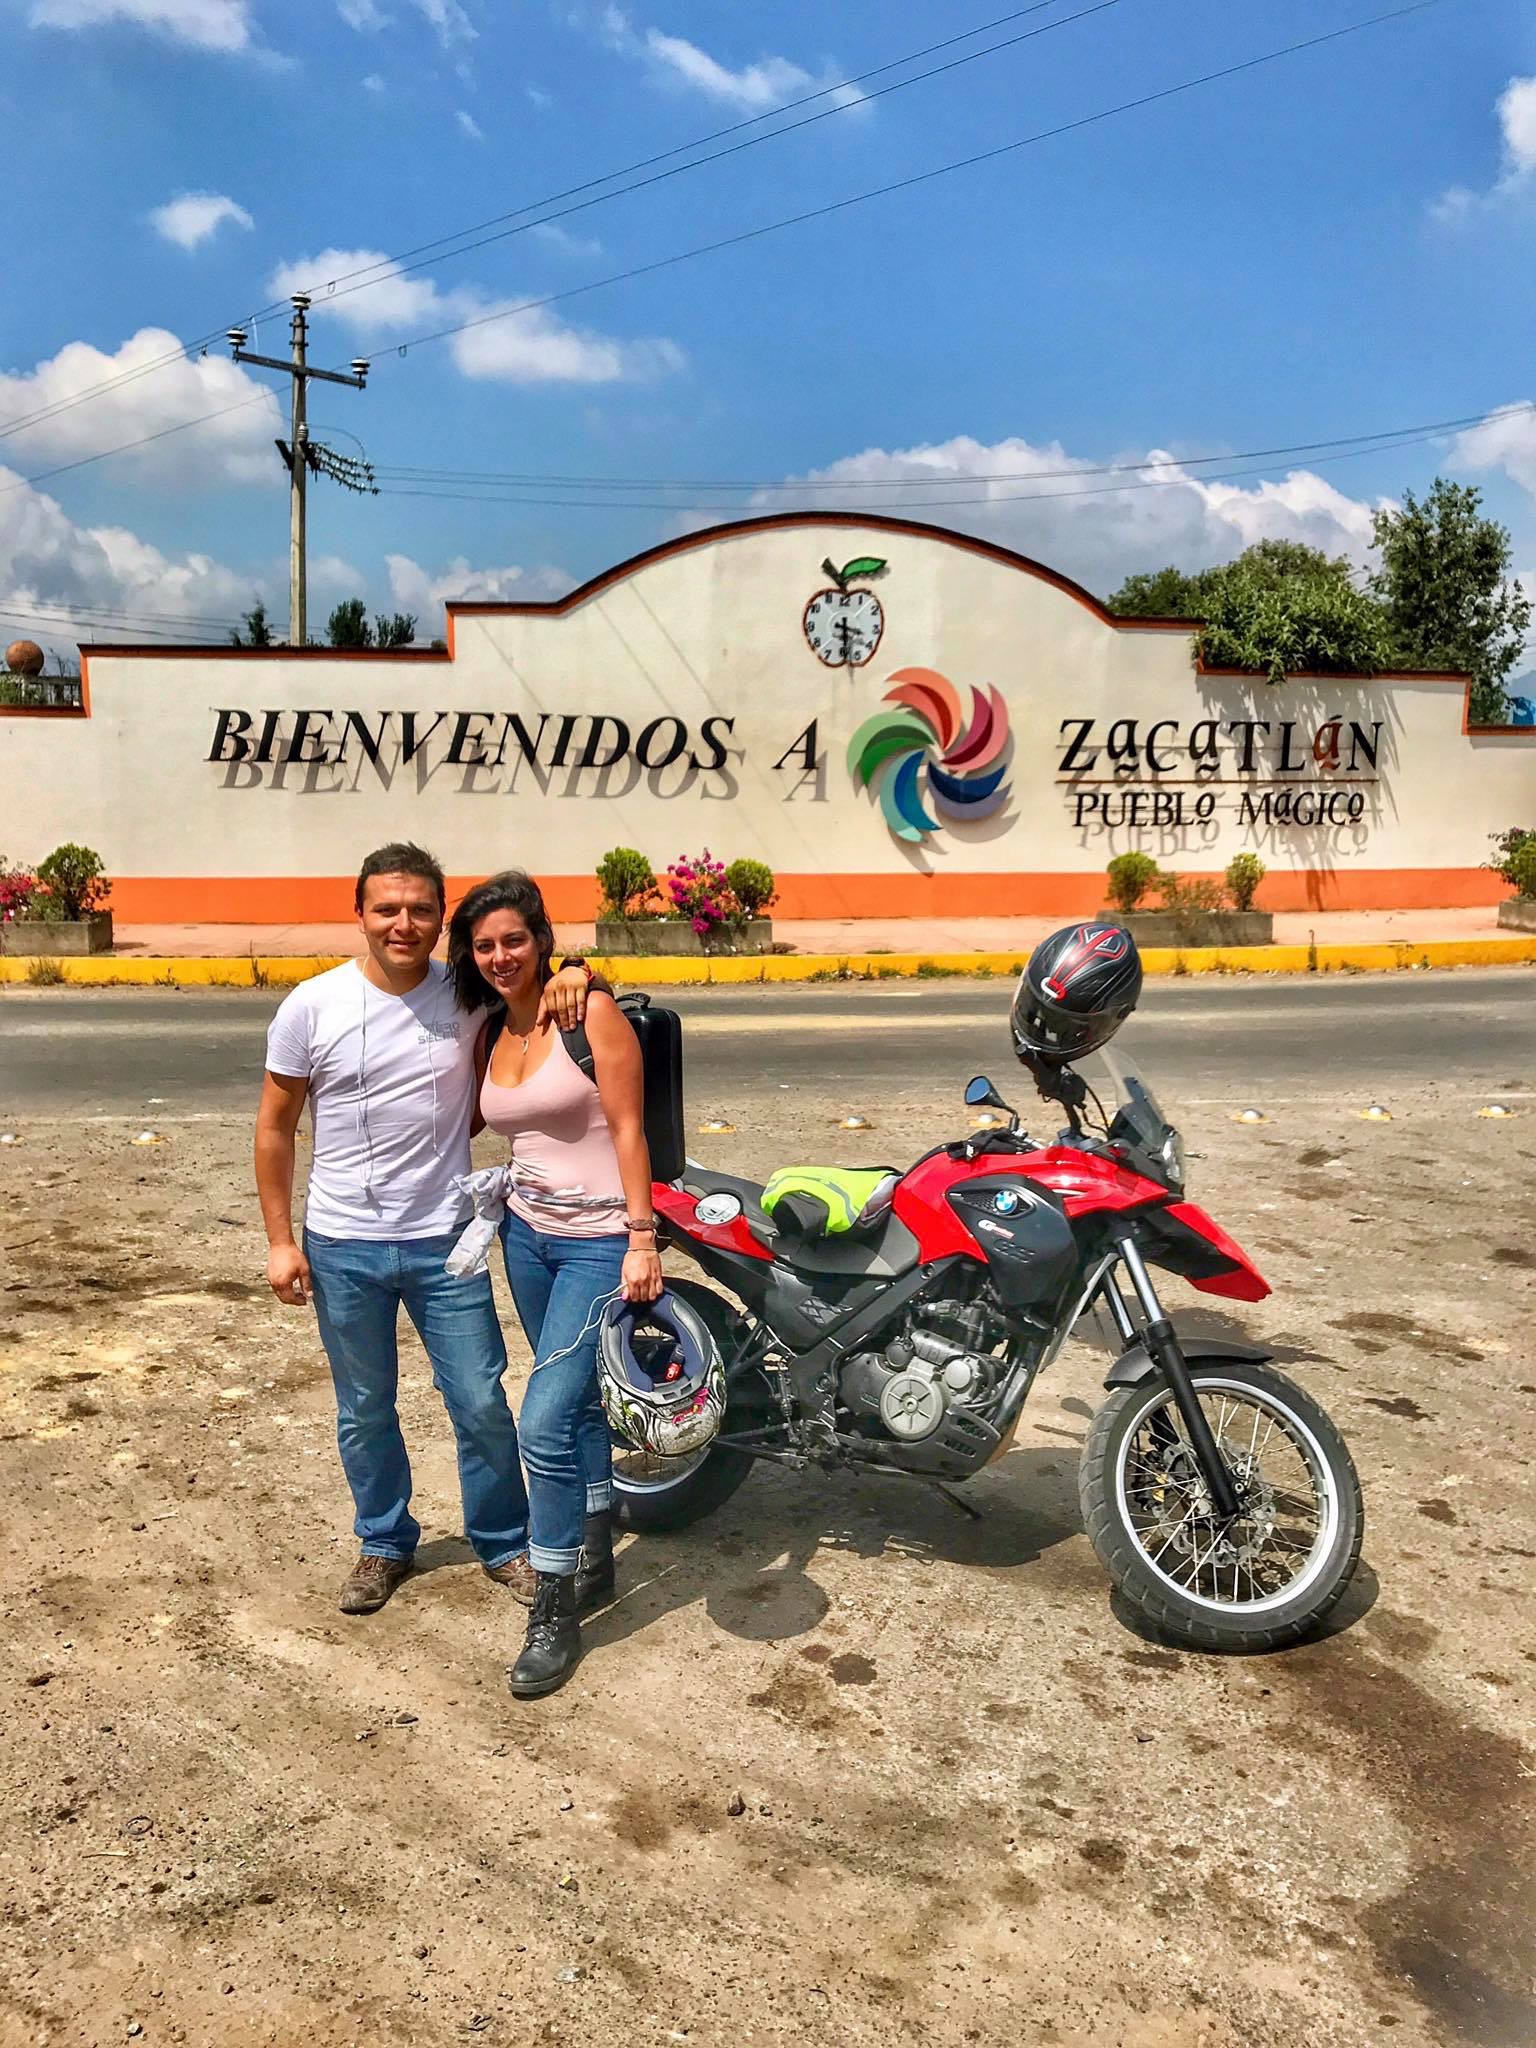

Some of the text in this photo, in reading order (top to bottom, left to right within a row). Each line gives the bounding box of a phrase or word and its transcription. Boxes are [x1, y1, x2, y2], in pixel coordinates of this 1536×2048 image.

[871, 605, 879, 616] 2
[865, 641, 873, 650] 4
[824, 649, 832, 660] 7
[204, 709, 820, 770] BIENVENIDOS A
